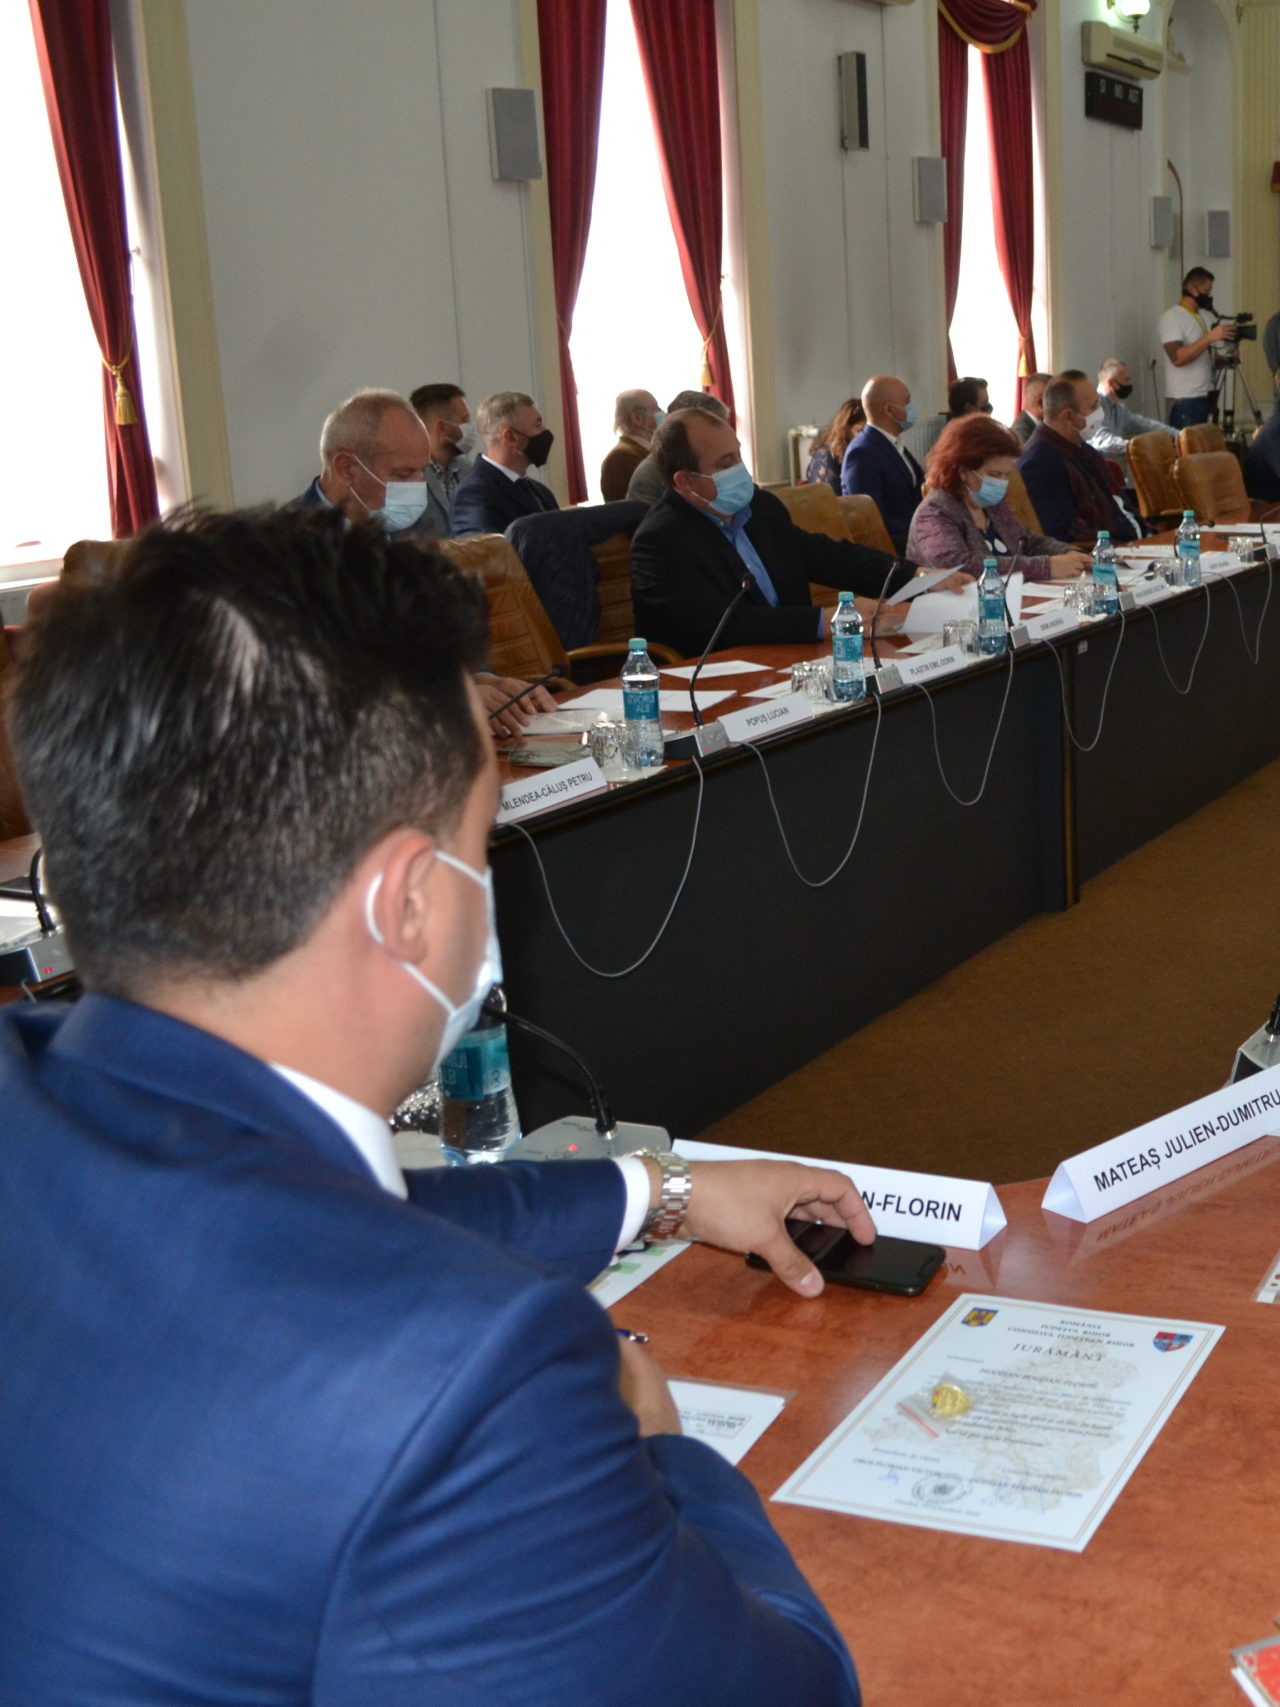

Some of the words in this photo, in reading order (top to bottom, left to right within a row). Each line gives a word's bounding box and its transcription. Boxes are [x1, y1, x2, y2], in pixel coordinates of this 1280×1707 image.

[767, 705, 790, 721] LUCIAN
[567, 770, 593, 793] PETRU
[1093, 1148, 1162, 1192] MATEAȘ
[861, 1190, 963, 1222] N-FLORIN
